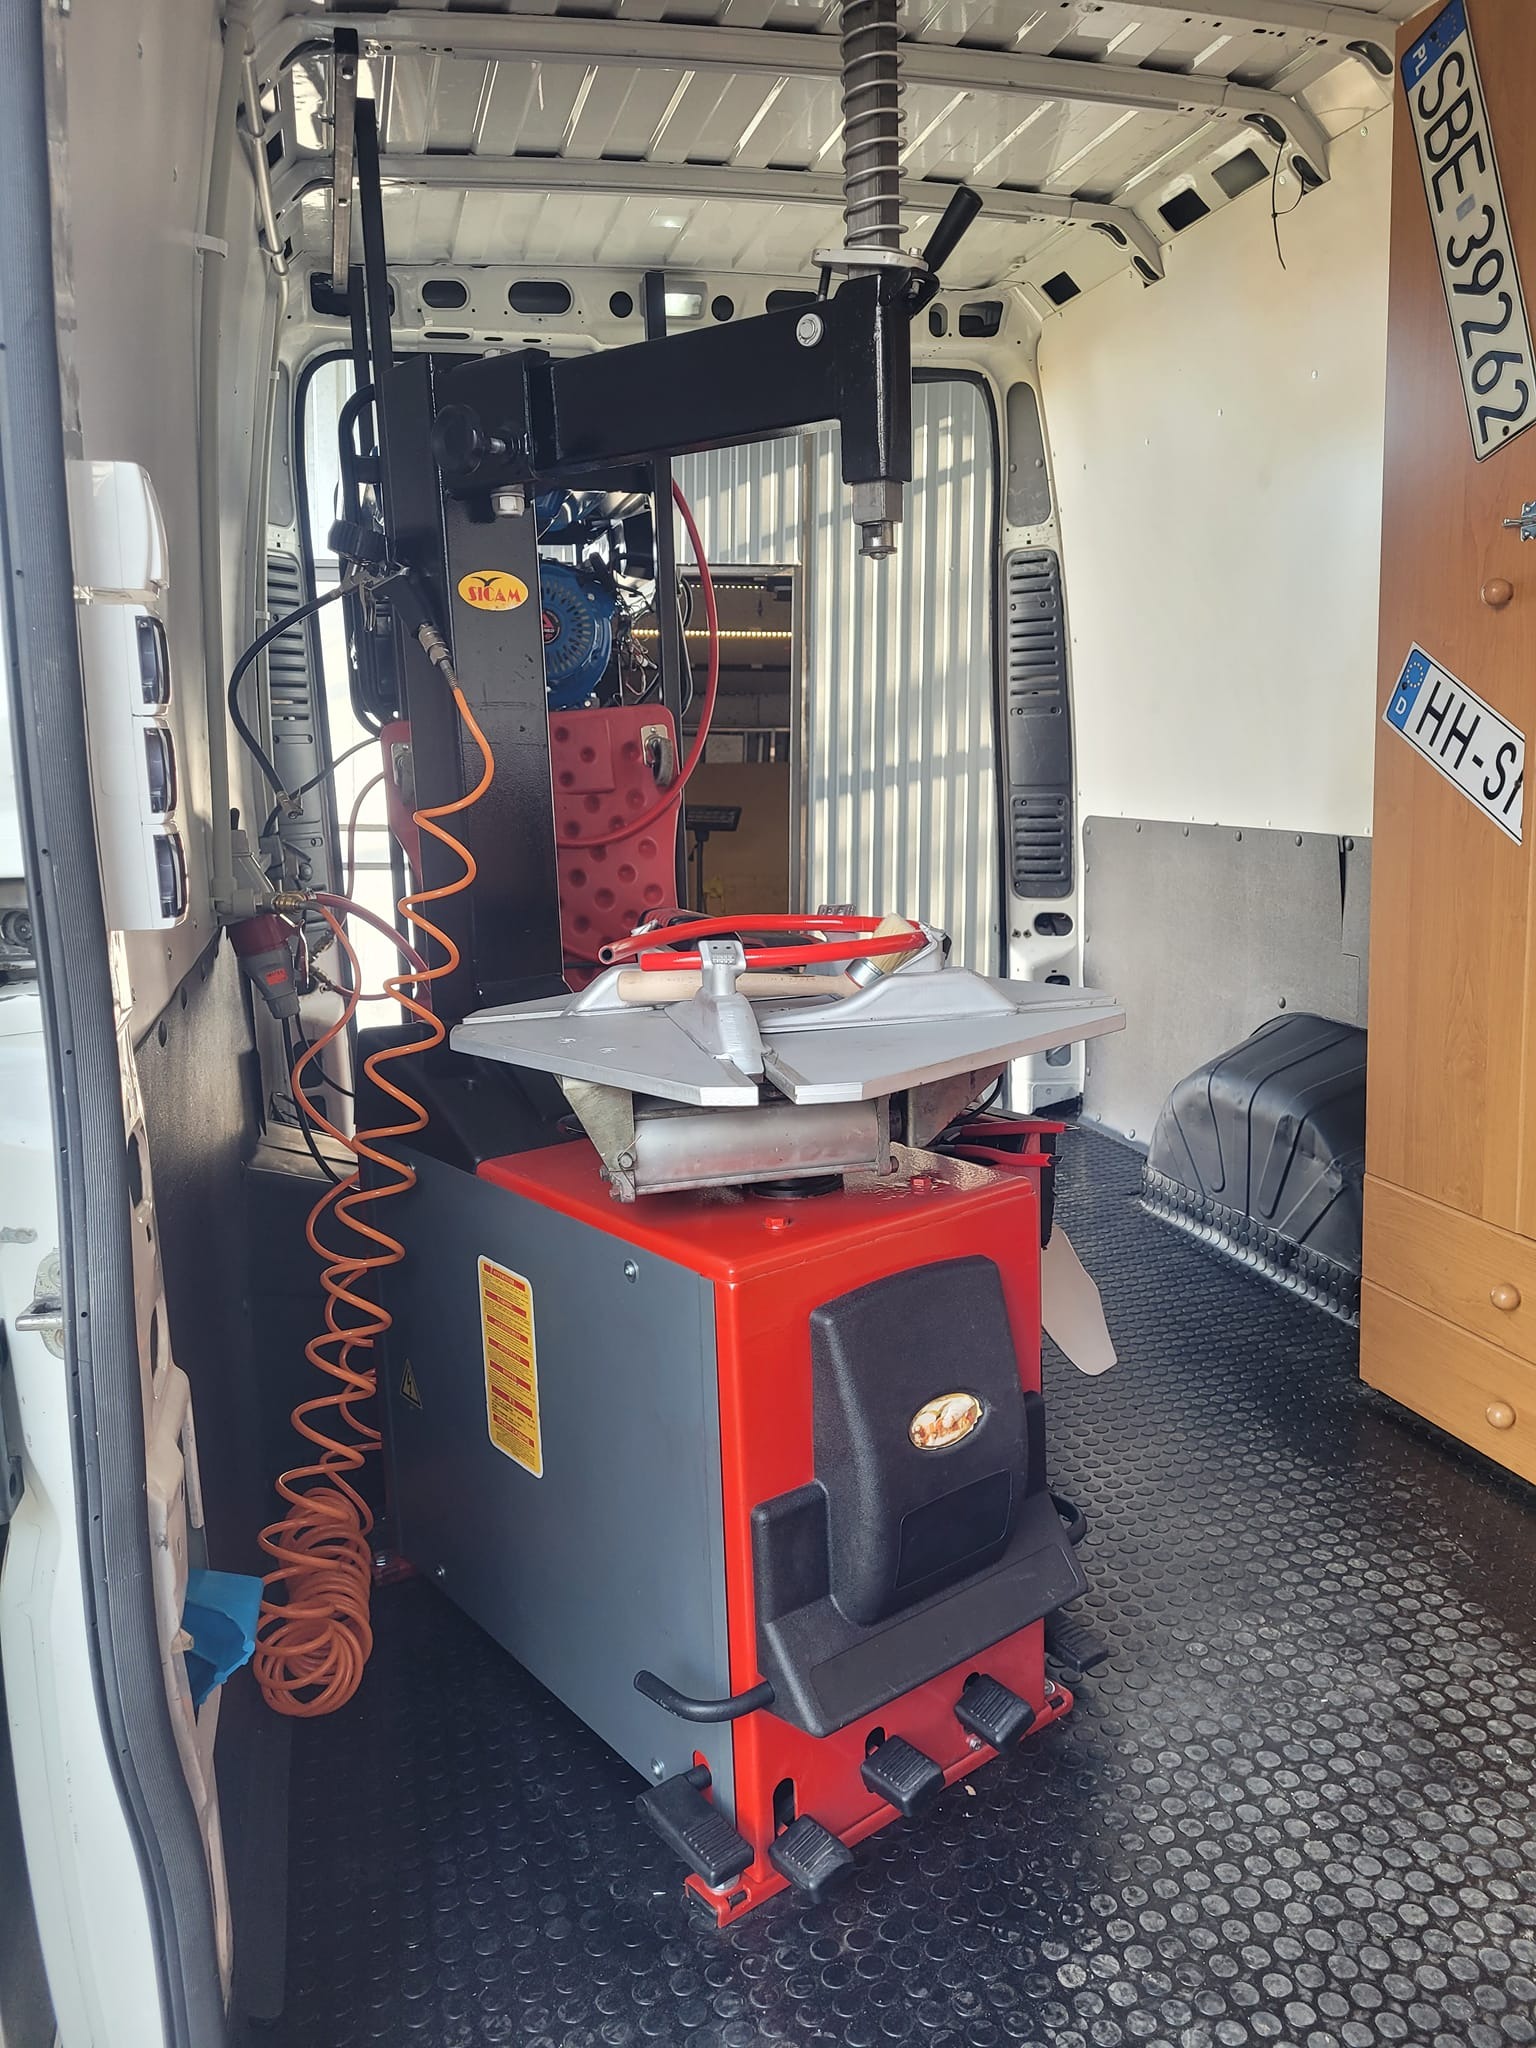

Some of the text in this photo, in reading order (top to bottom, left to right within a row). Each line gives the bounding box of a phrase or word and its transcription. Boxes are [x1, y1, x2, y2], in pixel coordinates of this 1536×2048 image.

[1412, 43, 1427, 76] PL
[1419, 51, 1529, 444] SBE 39262
[468, 586, 521, 603] SICAM
[1395, 696, 1407, 715] D
